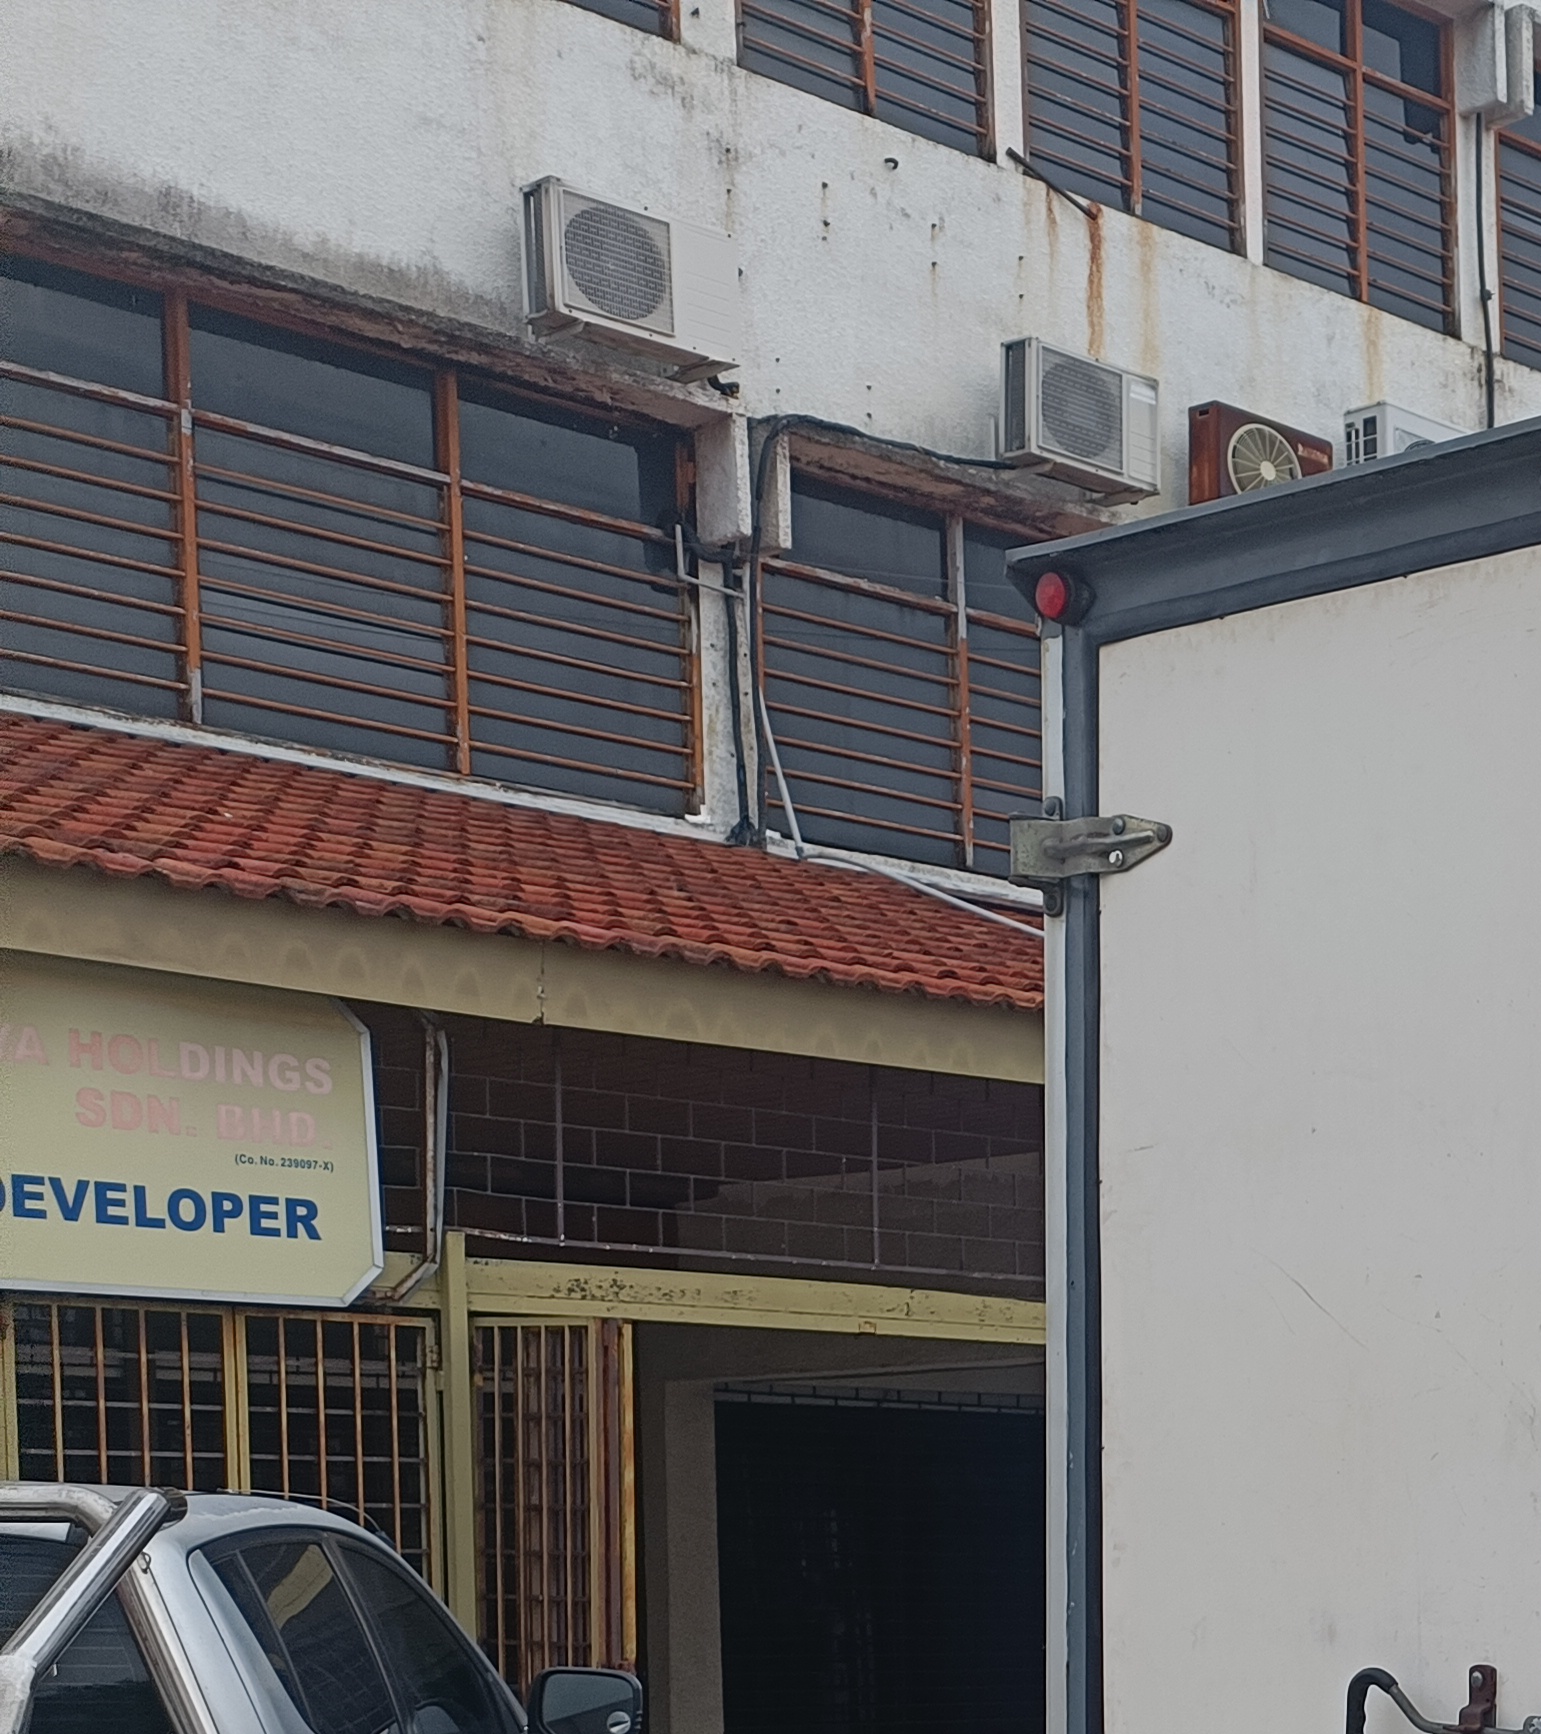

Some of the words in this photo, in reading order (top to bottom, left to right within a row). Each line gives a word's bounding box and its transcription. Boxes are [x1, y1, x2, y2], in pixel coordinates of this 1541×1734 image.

[68, 1027, 333, 1095] HOLDINGS
[75, 1087, 197, 1137] SDN.
[217, 1103, 333, 1150] BHD.
[235, 1153, 257, 1166] (Co.
[260, 1155, 279, 1167] No.
